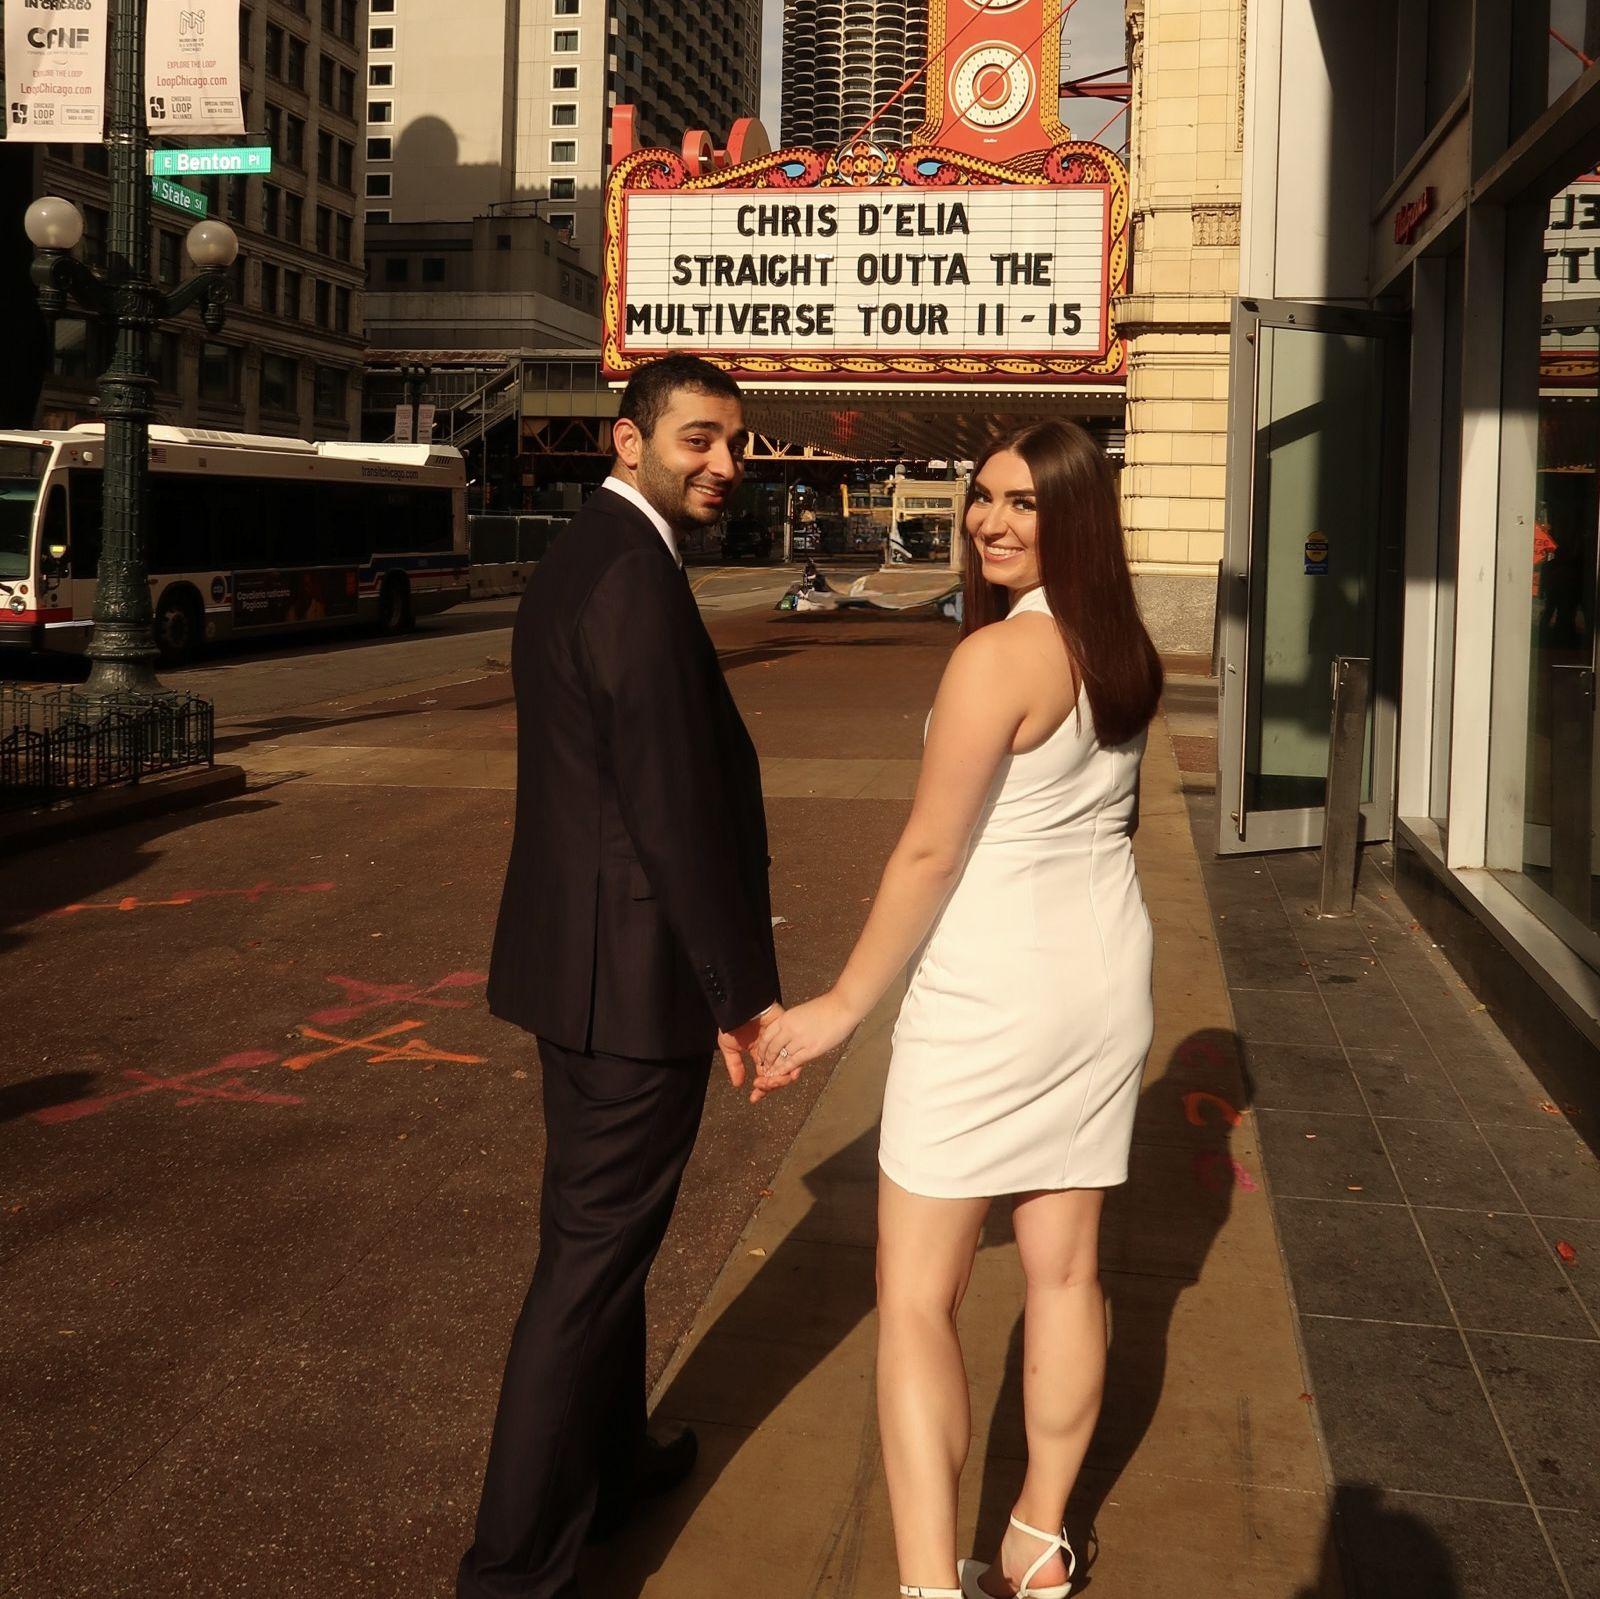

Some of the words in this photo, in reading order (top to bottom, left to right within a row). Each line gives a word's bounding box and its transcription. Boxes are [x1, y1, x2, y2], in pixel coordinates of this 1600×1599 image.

[24, 0, 38, 9] IN
[20, 83, 92, 97] LoopChicago.com
[157, 75, 228, 89] LoopChicago.com
[33, 109, 55, 119] LOOP
[171, 103, 192, 113] LOOP
[164, 156, 172, 168] E
[177, 153, 242, 171] Benton
[248, 154, 260, 166] Pl
[161, 183, 191, 208] State
[194, 197, 202, 210] St
[737, 204, 837, 237] CHRIS
[858, 203, 970, 237] D'ELIA
[672, 254, 833, 287] STRAIGHT
[856, 253, 970, 286] OUTTA
[990, 253, 1053, 287] THE
[625, 303, 834, 337] MULTIVERSE
[857, 303, 949, 336] TOUR
[361, 465, 419, 481] transitchicago.com
